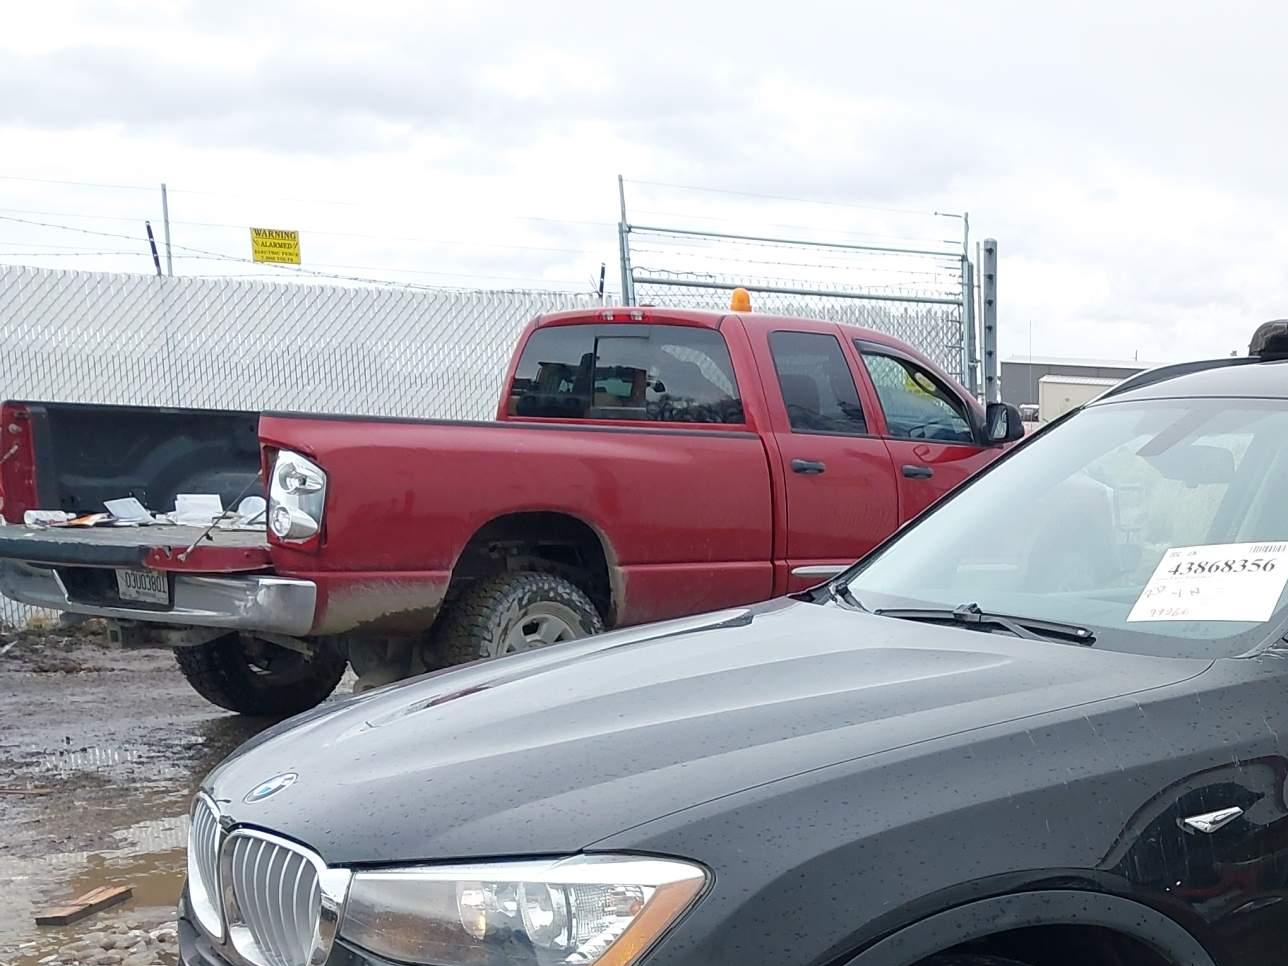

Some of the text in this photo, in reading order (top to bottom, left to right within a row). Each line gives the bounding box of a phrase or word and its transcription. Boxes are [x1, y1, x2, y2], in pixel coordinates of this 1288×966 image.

[253, 228, 296, 239] WARNING
[260, 241, 292, 249] ALARMED
[1167, 558, 1277, 576] 43868356
